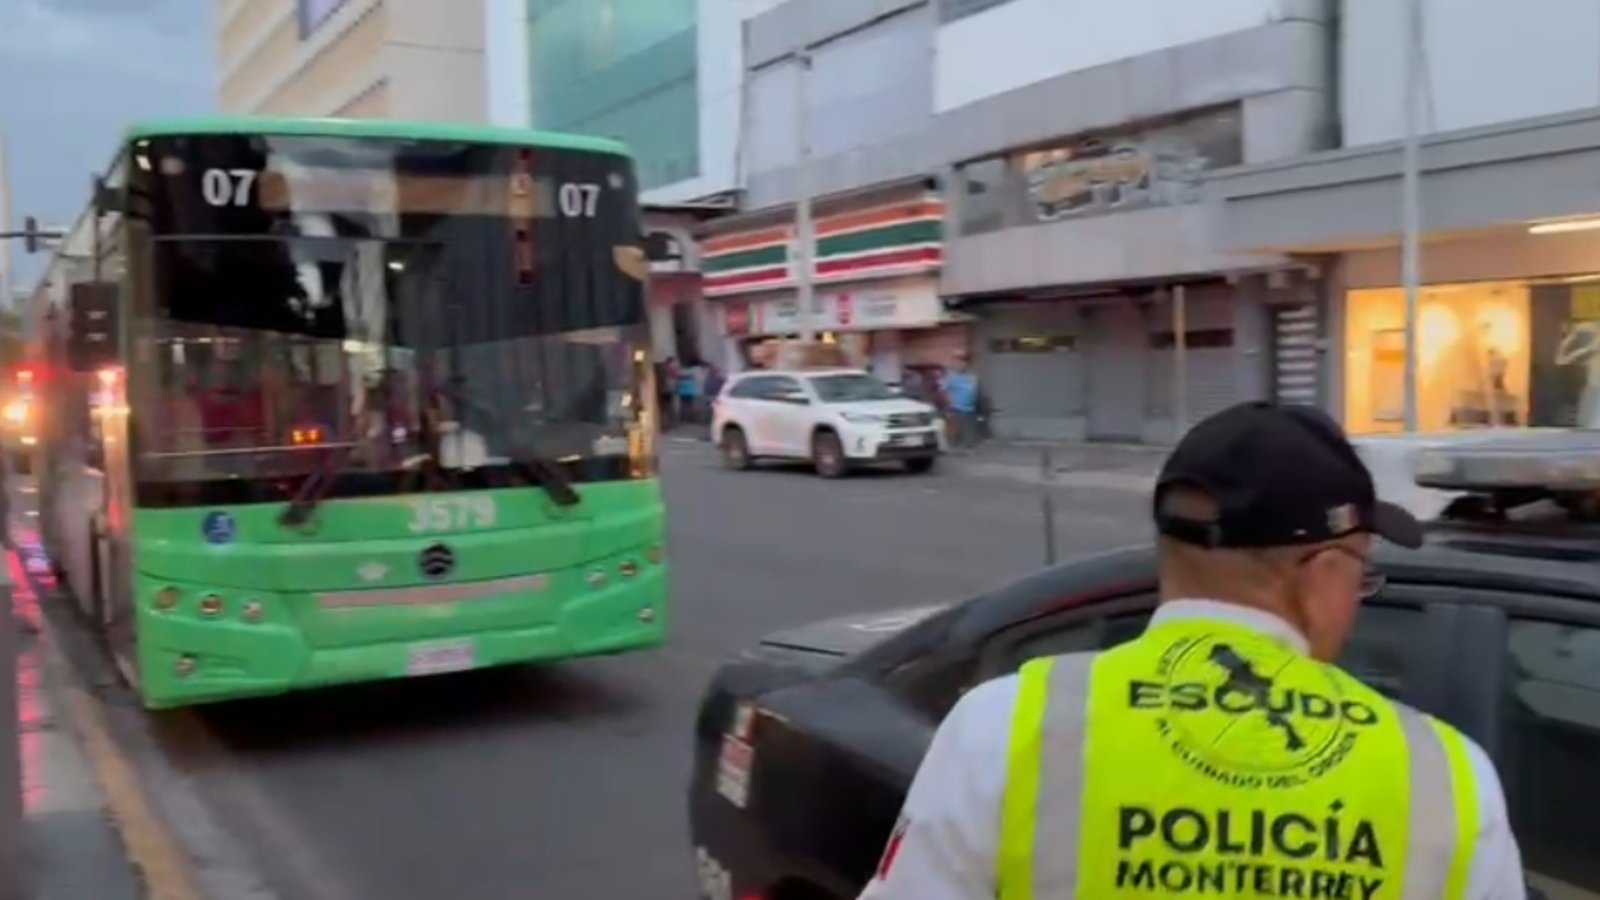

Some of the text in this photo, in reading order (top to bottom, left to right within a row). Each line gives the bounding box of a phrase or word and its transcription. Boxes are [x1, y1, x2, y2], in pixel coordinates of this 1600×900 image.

[202, 169, 256, 208] 07
[559, 182, 600, 218] 07
[408, 495, 496, 533] 3579
[1129, 680, 1378, 726] ESCUDO
[1118, 799, 1383, 868] POLICÍA
[1115, 860, 1384, 900] MONTERREY
